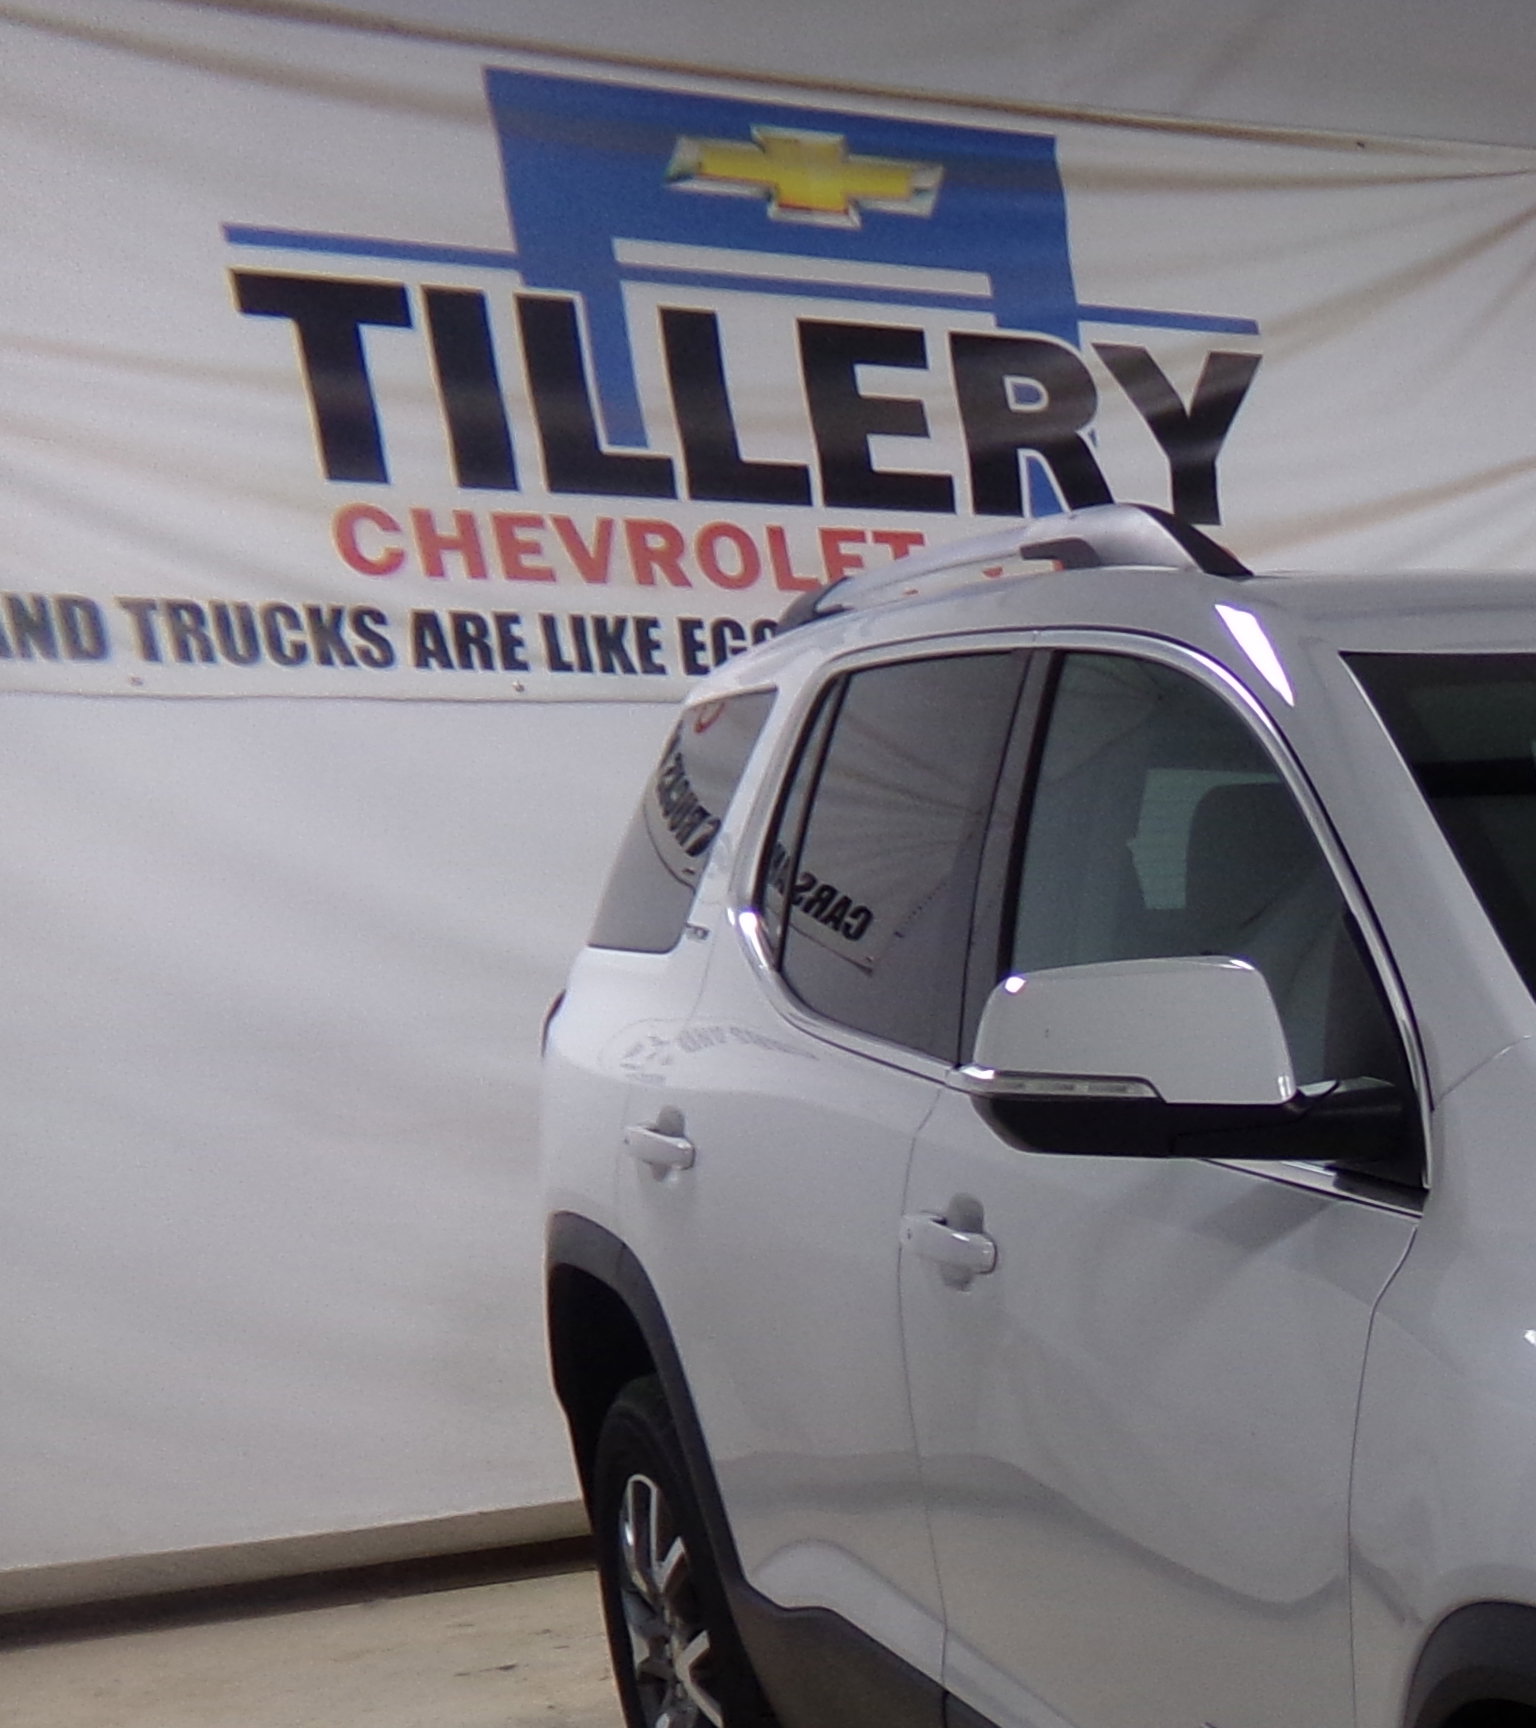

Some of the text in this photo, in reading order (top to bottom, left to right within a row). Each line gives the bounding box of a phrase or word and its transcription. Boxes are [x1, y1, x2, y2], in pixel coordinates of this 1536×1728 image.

[227, 267, 1263, 526] TILLERY
[332, 503, 925, 591] CHEVROLET
[117, 597, 394, 668] TRUCKS
[411, 608, 529, 672] ARE
[539, 612, 667, 676] LIKE
